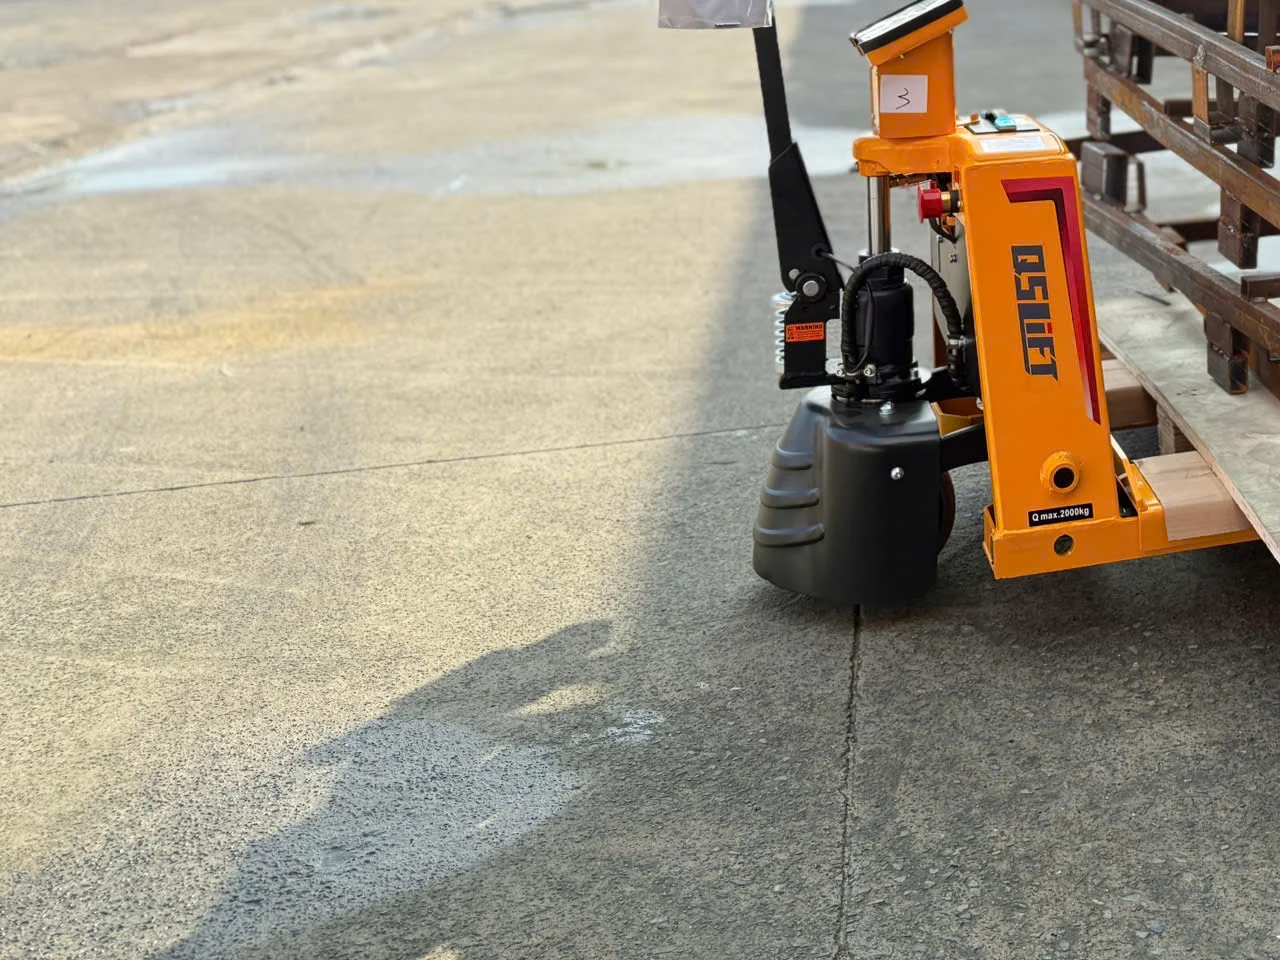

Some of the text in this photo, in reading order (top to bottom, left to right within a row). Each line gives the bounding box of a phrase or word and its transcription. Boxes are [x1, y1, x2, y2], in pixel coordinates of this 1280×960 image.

[896, 87, 910, 110] 3
[1032, 507, 1090, 521] Q max.2000kg
